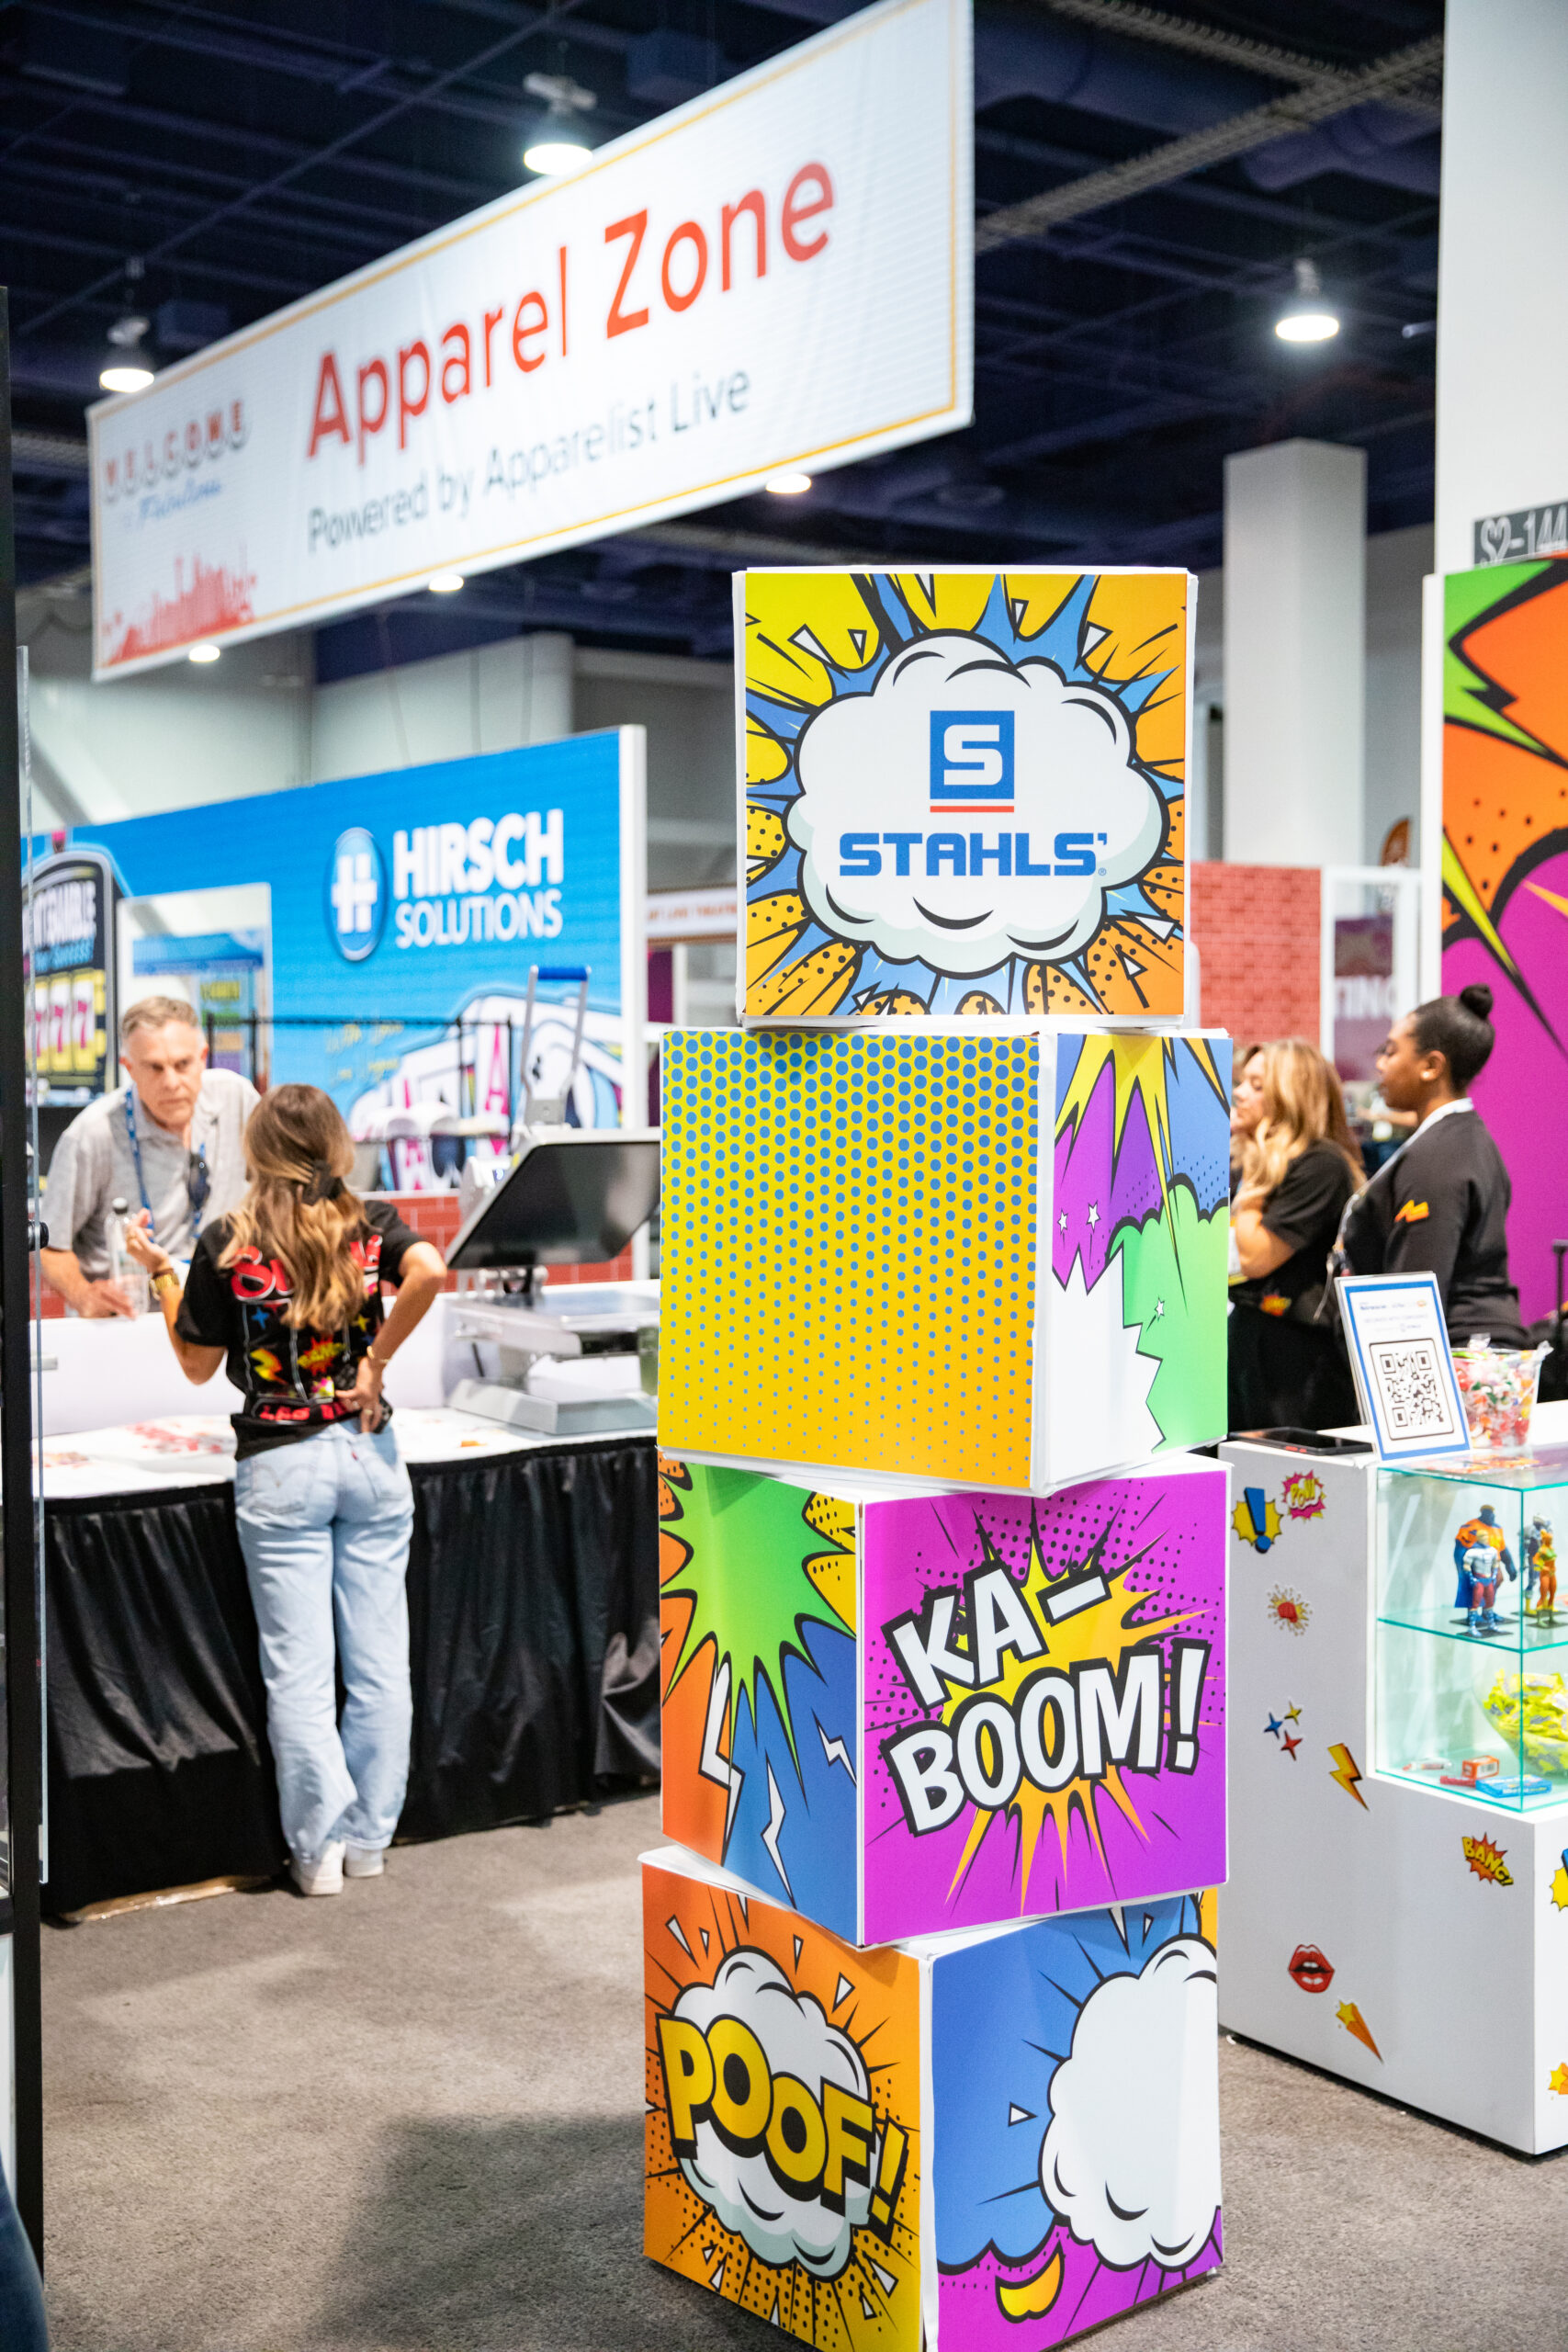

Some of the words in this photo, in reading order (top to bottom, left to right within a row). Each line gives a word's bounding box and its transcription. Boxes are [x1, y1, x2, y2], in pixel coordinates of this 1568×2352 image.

[307, 245, 568, 467] Apparel
[603, 162, 835, 340] Zone
[308, 469, 429, 552] Powered
[439, 461, 475, 517] by
[483, 399, 658, 498] Apparelist
[671, 368, 750, 433] Live
[393, 808, 565, 901] HIRSCH
[395, 888, 563, 949] SOLUTIONS
[884, 1559, 1111, 1708] KA-
[883, 1641, 1209, 1836] BOOM!
[1461, 1836, 1515, 1886] BANG!
[656, 2014, 908, 2238] POOF!
